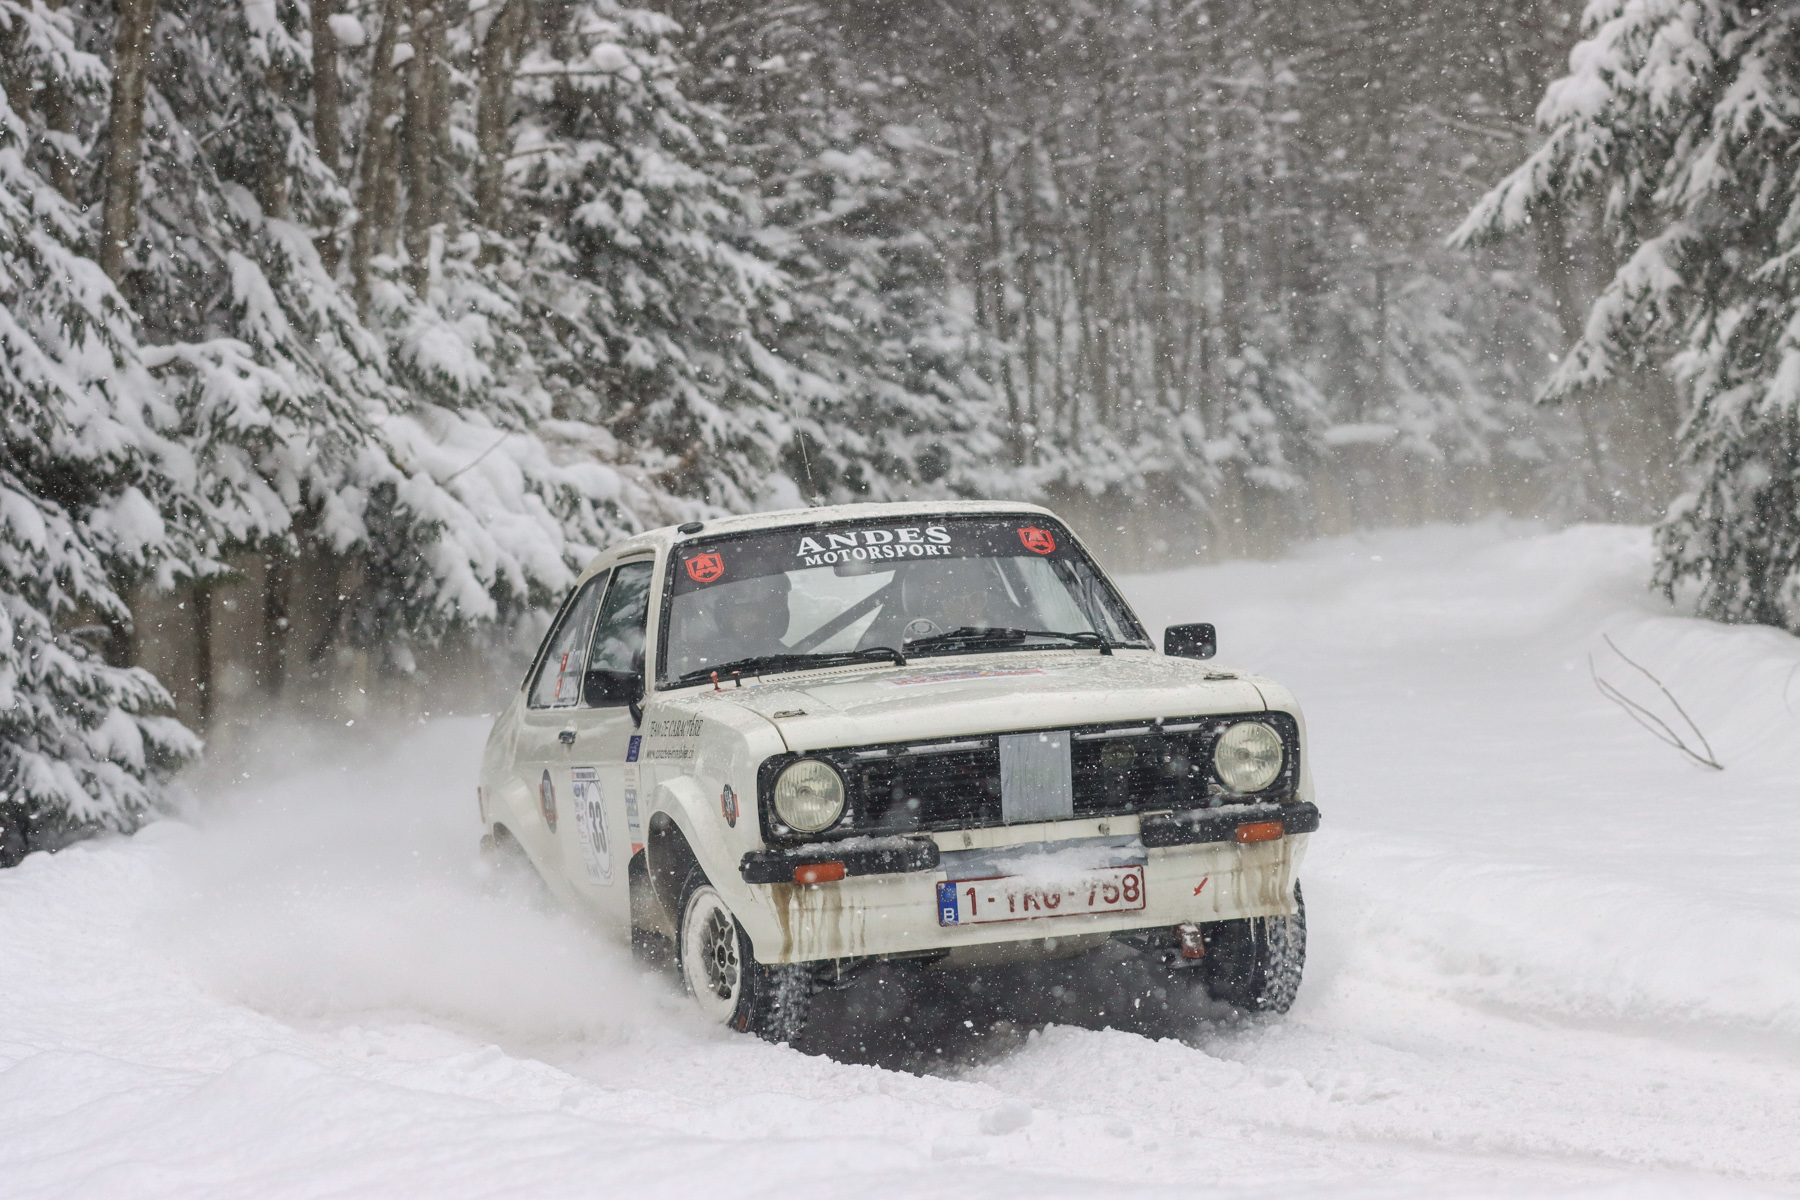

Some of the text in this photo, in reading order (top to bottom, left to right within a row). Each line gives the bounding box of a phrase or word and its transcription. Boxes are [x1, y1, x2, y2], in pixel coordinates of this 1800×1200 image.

[796, 526, 952, 557] ANDES
[803, 543, 952, 567] MOTORSPORT
[588, 800, 608, 854] 33
[943, 907, 955, 922] B
